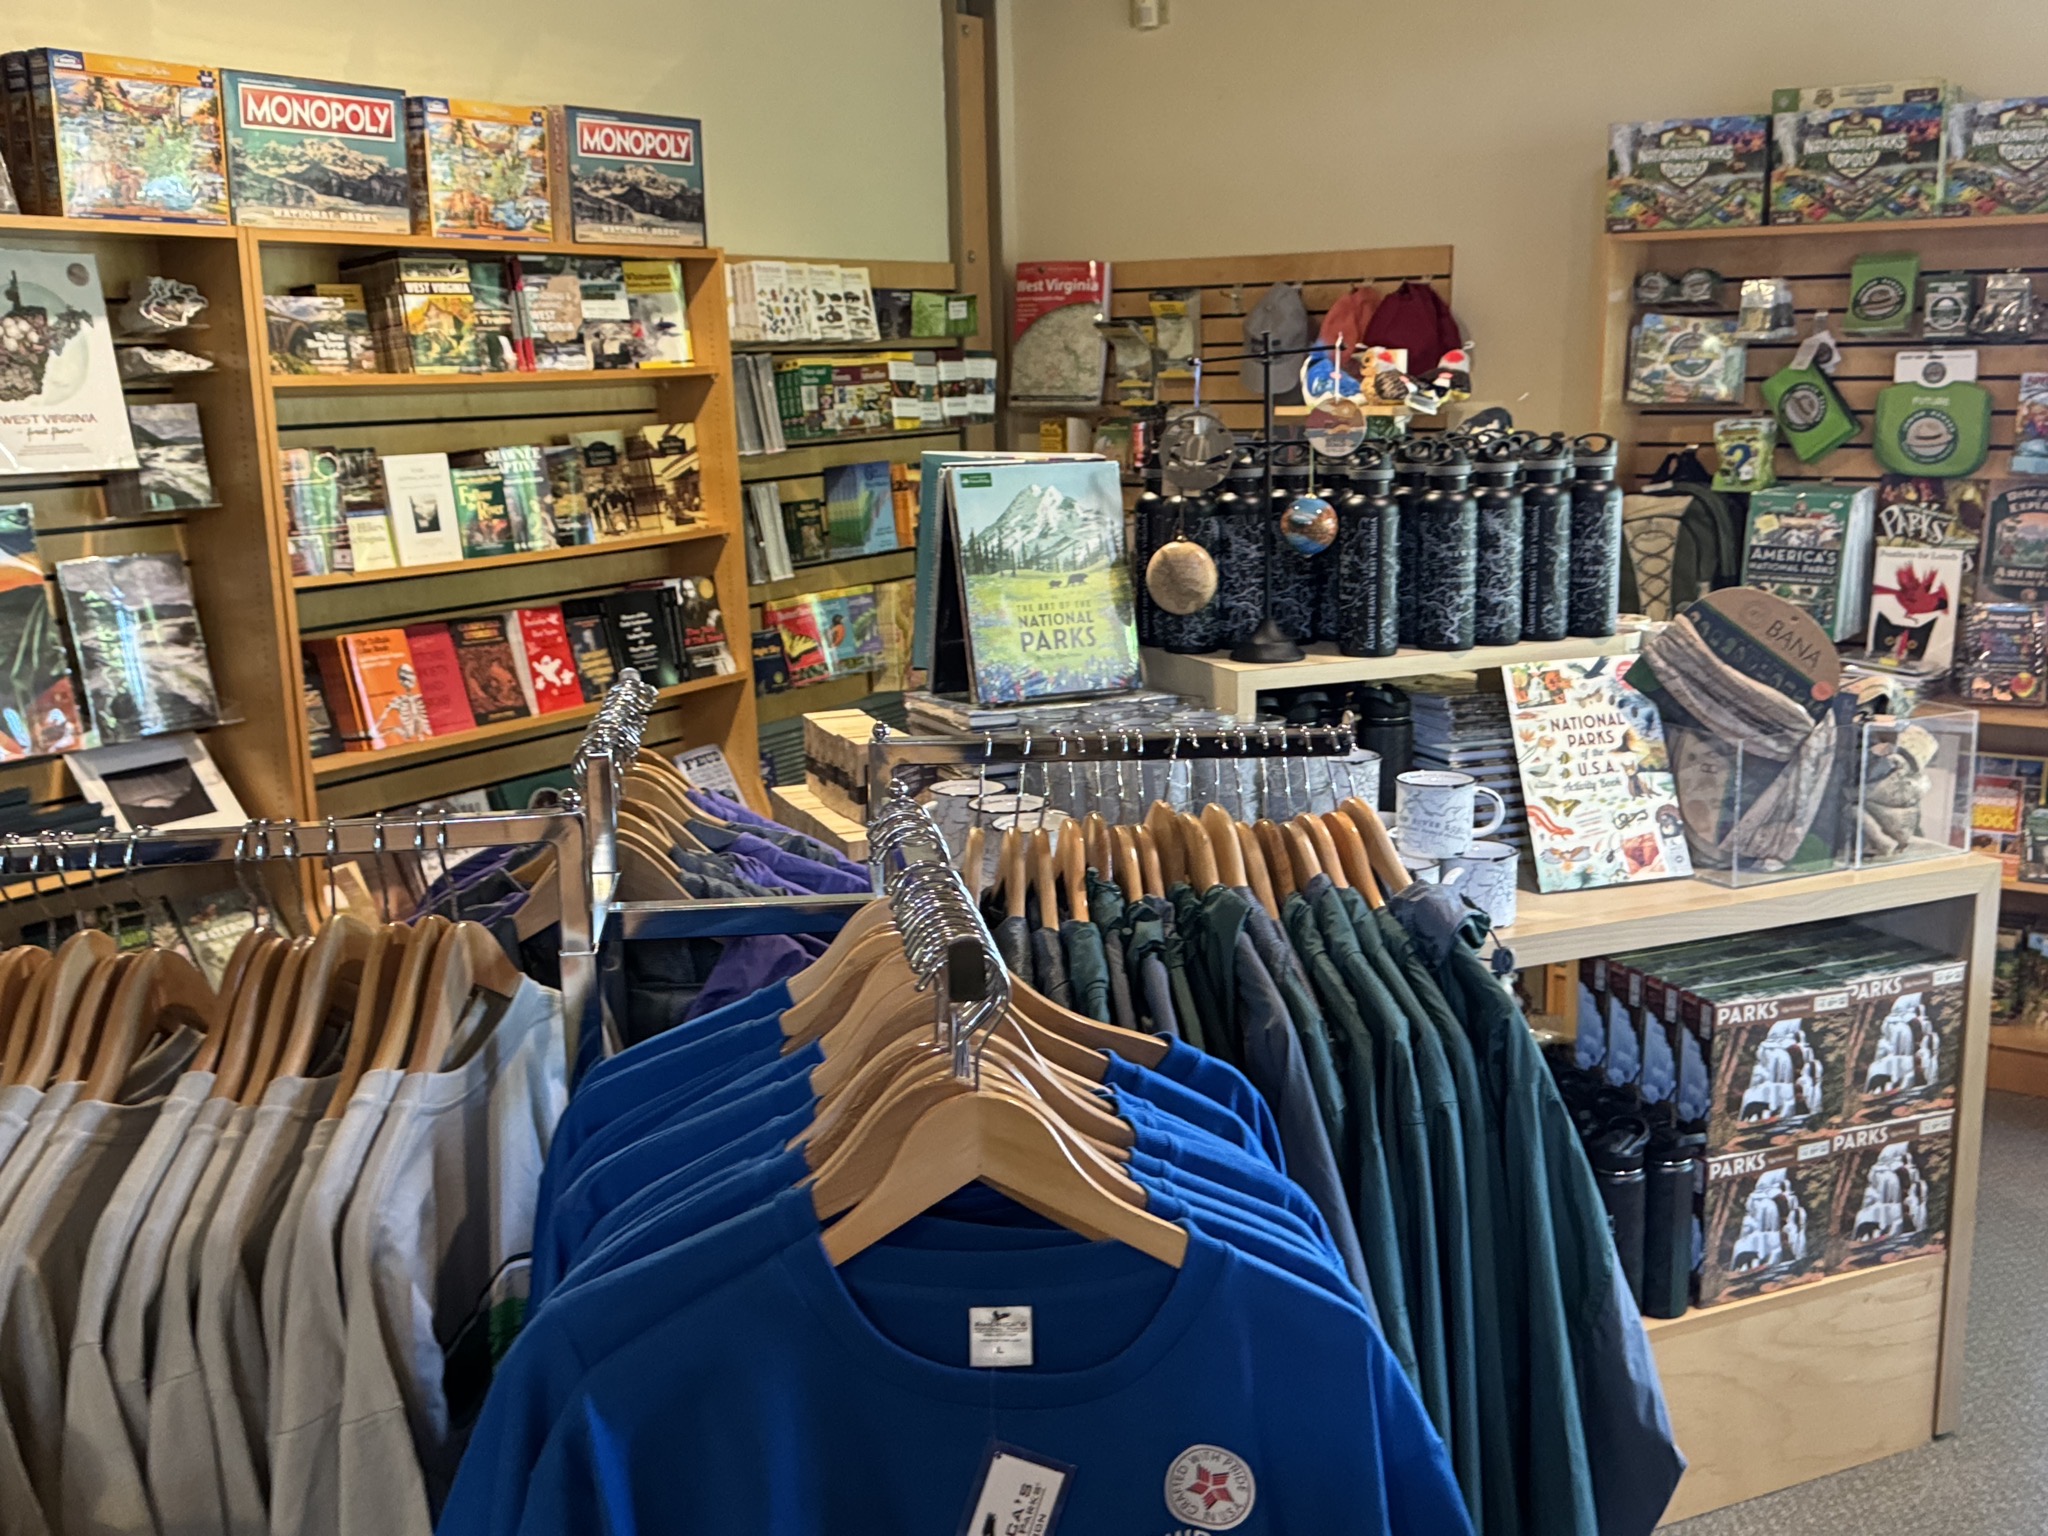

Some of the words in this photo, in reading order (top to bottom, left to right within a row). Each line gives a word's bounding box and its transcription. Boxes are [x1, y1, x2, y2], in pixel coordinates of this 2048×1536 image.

[246, 93, 390, 134] MONOPOLY
[581, 126, 691, 159] MONOPOLY
[405, 282, 430, 294] WEST
[432, 282, 472, 294] VIRGINIA
[1016, 279, 1044, 292] West
[1046, 278, 1099, 295] Virginia
[1, 413, 39, 425] WEST
[45, 413, 98, 424] VIRGINIA
[1369, 515, 1379, 554] VIRGINIA
[1878, 503, 1957, 545] PARKS
[1368, 557, 1378, 578] WEST
[1750, 546, 1837, 566] AMERICA'S
[1016, 604, 1033, 612] THE
[1038, 602, 1056, 611] ART
[1059, 601, 1071, 610] OF
[1073, 600, 1091, 609] THE
[1367, 584, 1377, 617] HEAVEN
[1018, 611, 1095, 629] NATIONAL
[1019, 626, 1097, 652] PARKS
[1366, 618, 1377, 650] ALMOST
[1766, 620, 1821, 671] BANA
[1550, 713, 1626, 732] NATIONAL
[1567, 730, 1615, 748] PARKS
[1581, 749, 1589, 759] of
[1592, 748, 1604, 757] the
[1849, 977, 1903, 999] PARKS
[1716, 1001, 1779, 1026] PARKS
[1832, 1127, 1888, 1152] PARKS
[1709, 1153, 1766, 1181] PARKS
